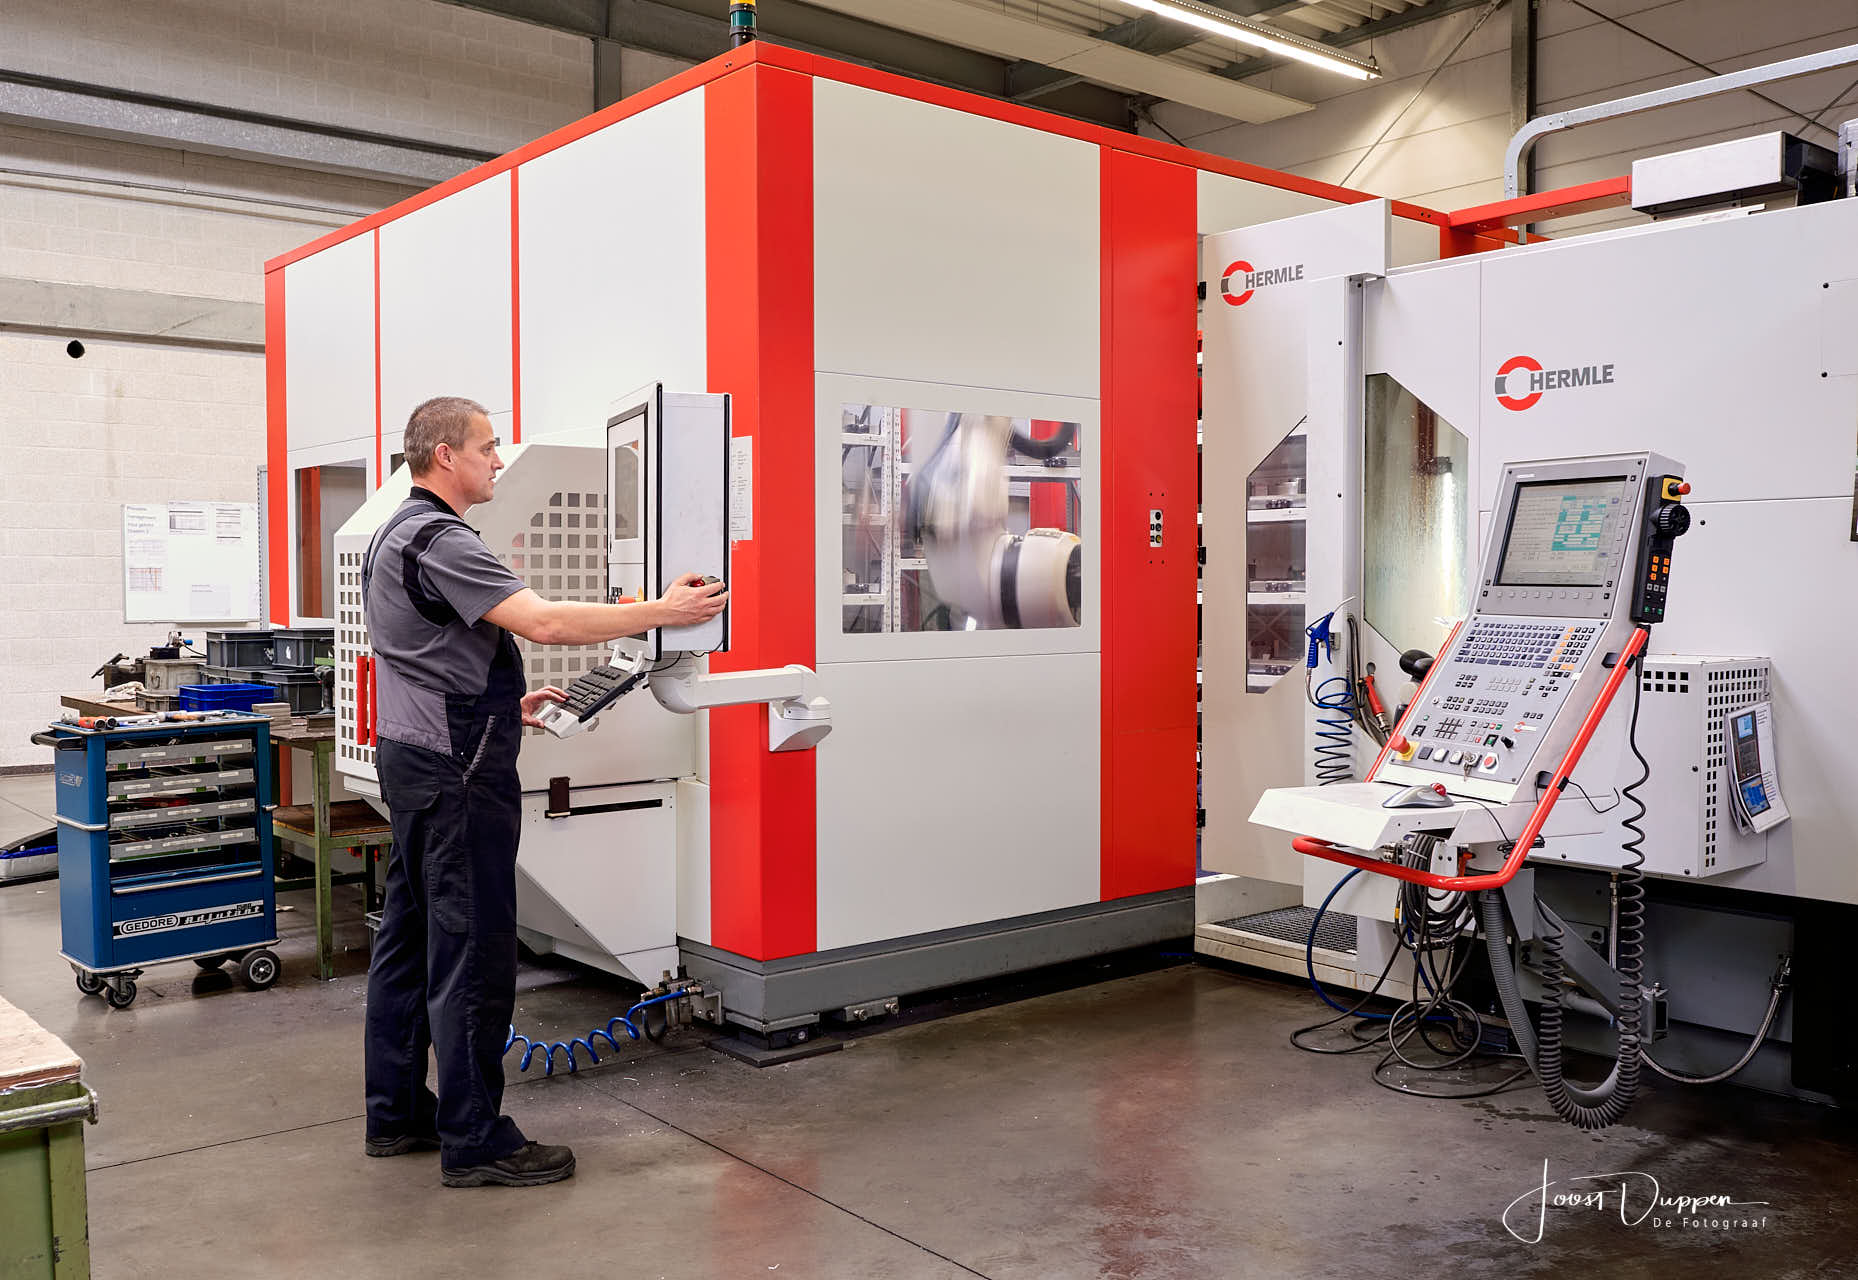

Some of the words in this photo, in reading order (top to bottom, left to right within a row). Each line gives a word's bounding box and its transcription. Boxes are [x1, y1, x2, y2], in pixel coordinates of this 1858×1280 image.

[1246, 264, 1303, 289] HERMLE
[1530, 364, 1614, 391] HERMLE
[126, 917, 174, 932] GEDORE
